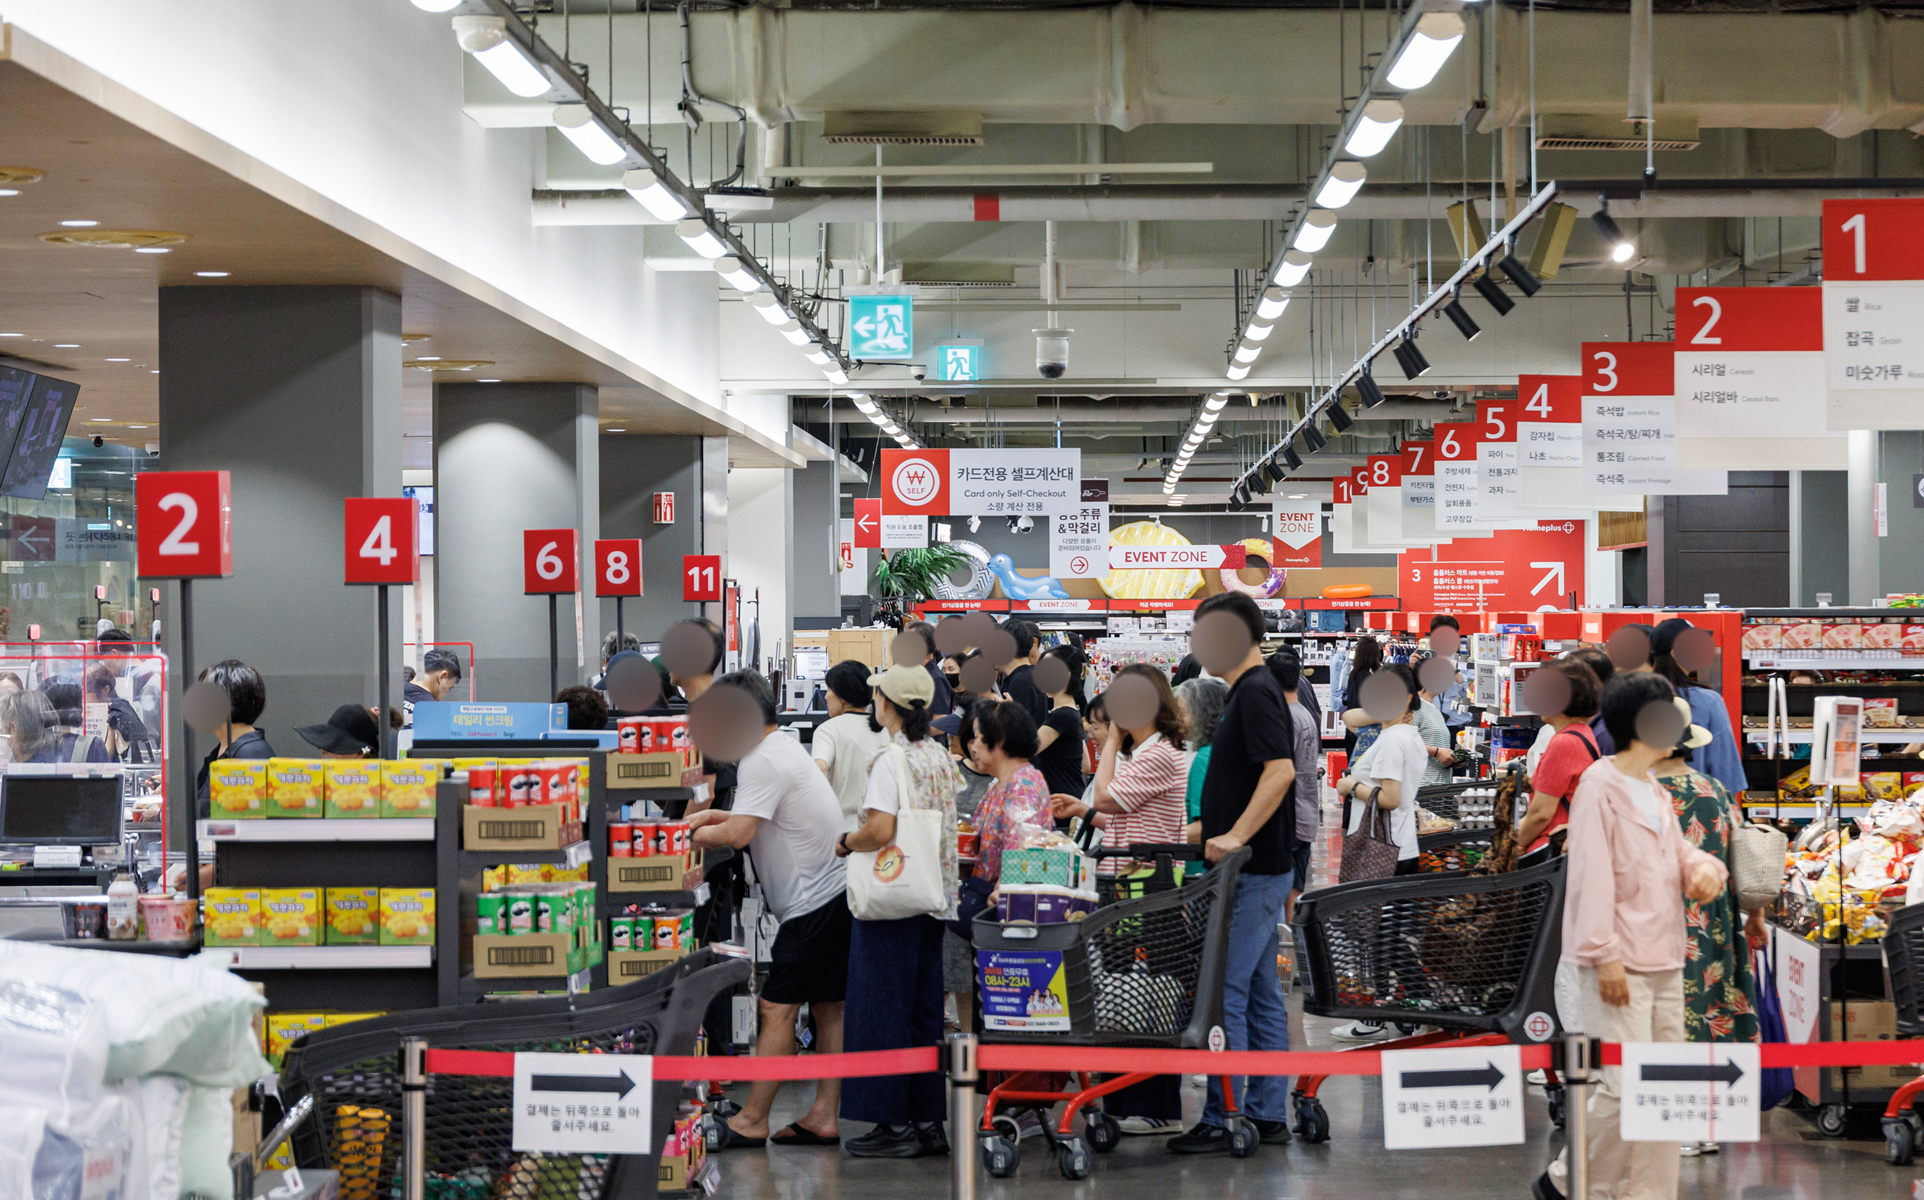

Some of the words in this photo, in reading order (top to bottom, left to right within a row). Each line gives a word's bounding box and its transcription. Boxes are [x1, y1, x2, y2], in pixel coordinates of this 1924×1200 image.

[1841, 213, 1866, 274] 1
[1845, 297, 1860, 312] 쌀
[1690, 296, 1722, 344] 2
[1845, 331, 1874, 347] 잡곡
[1592, 351, 1618, 392] 3
[1692, 364, 1726, 376] 시리얼
[1845, 365, 1903, 381] 미숫가루
[1525, 383, 1552, 418] 4
[1692, 391, 1738, 403] 시리얼바
[1596, 406, 1624, 417] 즉석밥
[1485, 407, 1505, 439] 5
[1529, 431, 1555, 442] 감자칩
[1441, 429, 1461, 458] 6
[1407, 447, 1424, 472] 7
[1488, 450, 1503, 459] 파이
[1529, 451, 1546, 461] 나초
[1596, 452, 1625, 463] 통조림
[957, 466, 1008, 482] 카드전용
[1011, 466, 1074, 482] 셀프계산대
[1372, 460, 1389, 484] 8
[1444, 467, 1471, 475] 주방세제
[1596, 474, 1624, 485] 즉석죽
[907, 487, 925, 495] SELF
[1339, 481, 1352, 502] 1
[1445, 483, 1465, 491] 건전지
[1488, 486, 1503, 494] 과자
[964, 489, 985, 498] Card
[986, 489, 1005, 499] only
[1007, 489, 1066, 498] Self-Checkout
[986, 502, 1005, 511] 소량
[1006, 502, 1024, 511] 계산
[1026, 502, 1043, 511] 전용
[1445, 499, 1472, 507] 일회용품
[157, 492, 200, 555] 2
[1280, 512, 1314, 522] EVENT
[1445, 515, 1472, 523] 고무장갑
[1280, 523, 1314, 533] ZONE
[359, 514, 397, 566] 4
[535, 540, 564, 581] 6
[1125, 551, 1167, 563] EVENT
[1171, 551, 1208, 562] ZONE
[605, 550, 630, 584] 8
[687, 566, 714, 592] 11
[1412, 569, 1421, 582] 3
[453, 714, 482, 726] 데일리
[485, 714, 514, 726] 썬크림
[1003, 967, 1029, 976] 연중무휴
[1397, 1101, 1433, 1114] 결제는
[1436, 1099, 1484, 1113] 뒤쪽으로
[1487, 1098, 1511, 1111] 돌아
[1634, 1093, 1671, 1107] 결제는
[1674, 1093, 1722, 1108] 뒤쪽으로
[1725, 1093, 1749, 1107] 돌아
[526, 1104, 561, 1117] 결제는
[565, 1104, 612, 1117] 뒤쪽으로
[617, 1105, 640, 1118] 돌아
[551, 1120, 614, 1132] 줄서주세요.
[1422, 1113, 1486, 1128] 줄서주세요.
